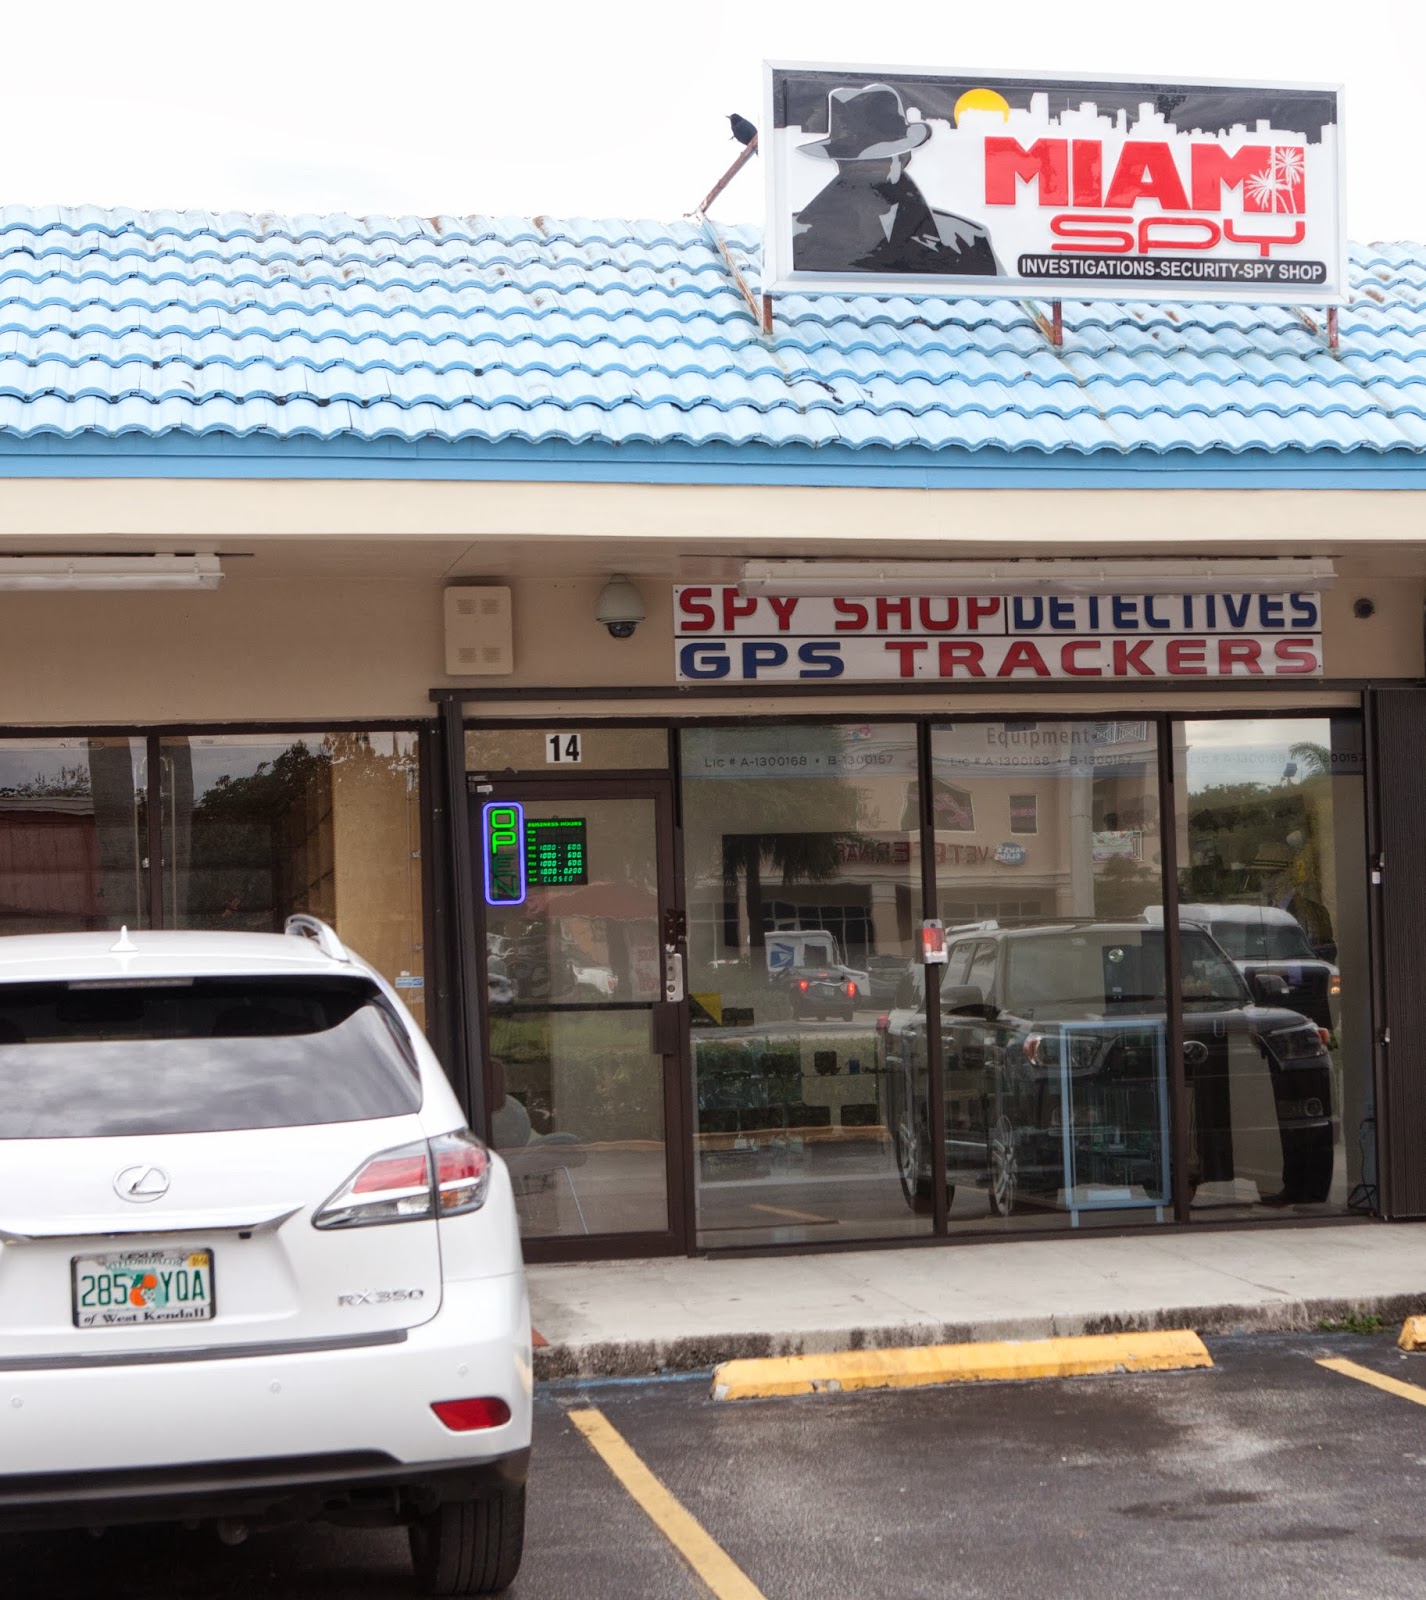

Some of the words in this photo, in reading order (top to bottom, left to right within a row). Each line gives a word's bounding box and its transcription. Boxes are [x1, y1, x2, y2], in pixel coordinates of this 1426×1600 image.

[984, 136, 1306, 214] MIAMI
[1050, 214, 1306, 257] SPY
[1278, 264, 1323, 280] SHOP
[679, 587, 799, 631] SPY
[680, 641, 845, 679] GPS
[885, 638, 1318, 678] TRACKERS
[549, 734, 580, 762] 14
[986, 727, 1090, 748] Equipment
[740, 756, 807, 767] A-1300168
[828, 754, 893, 765] B-1300157
[490, 808, 518, 899] OPEN
[81, 1273, 128, 1308] 285
[84, 1315, 97, 1326] of
[102, 1312, 138, 1323] West
[143, 1307, 205, 1322] Kendall
